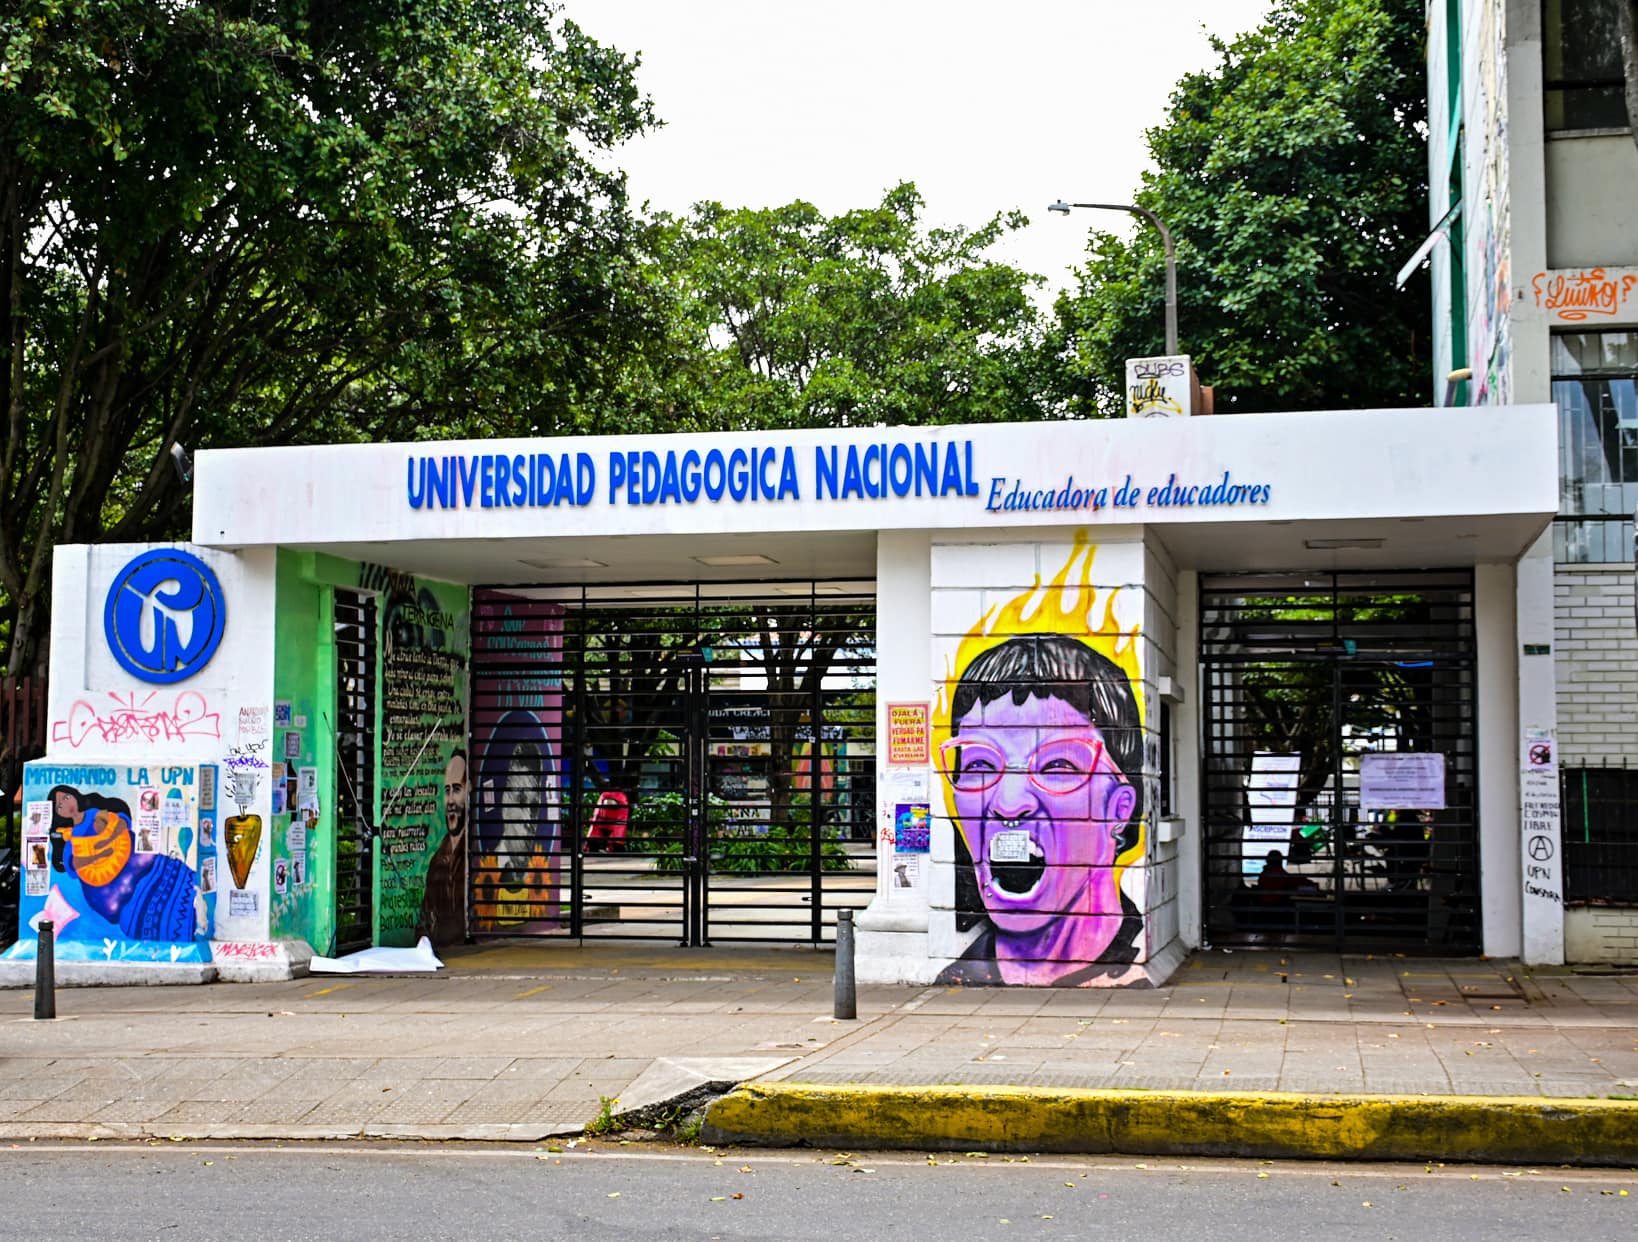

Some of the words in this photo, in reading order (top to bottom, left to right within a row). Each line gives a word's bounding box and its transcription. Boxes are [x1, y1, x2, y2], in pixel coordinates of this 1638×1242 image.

[407, 453, 596, 510] UNIVERSIDAD
[609, 445, 800, 504] PEDAGOGICA
[815, 440, 979, 500] NACIONAL
[985, 475, 1108, 511] Educadora
[1113, 474, 1139, 508] de
[1147, 470, 1271, 505] educadores
[24, 767, 116, 786] MATERNANDO
[127, 767, 150, 785] LA
[161, 767, 194, 785] UPN
[1527, 864, 1551, 880] UPN
